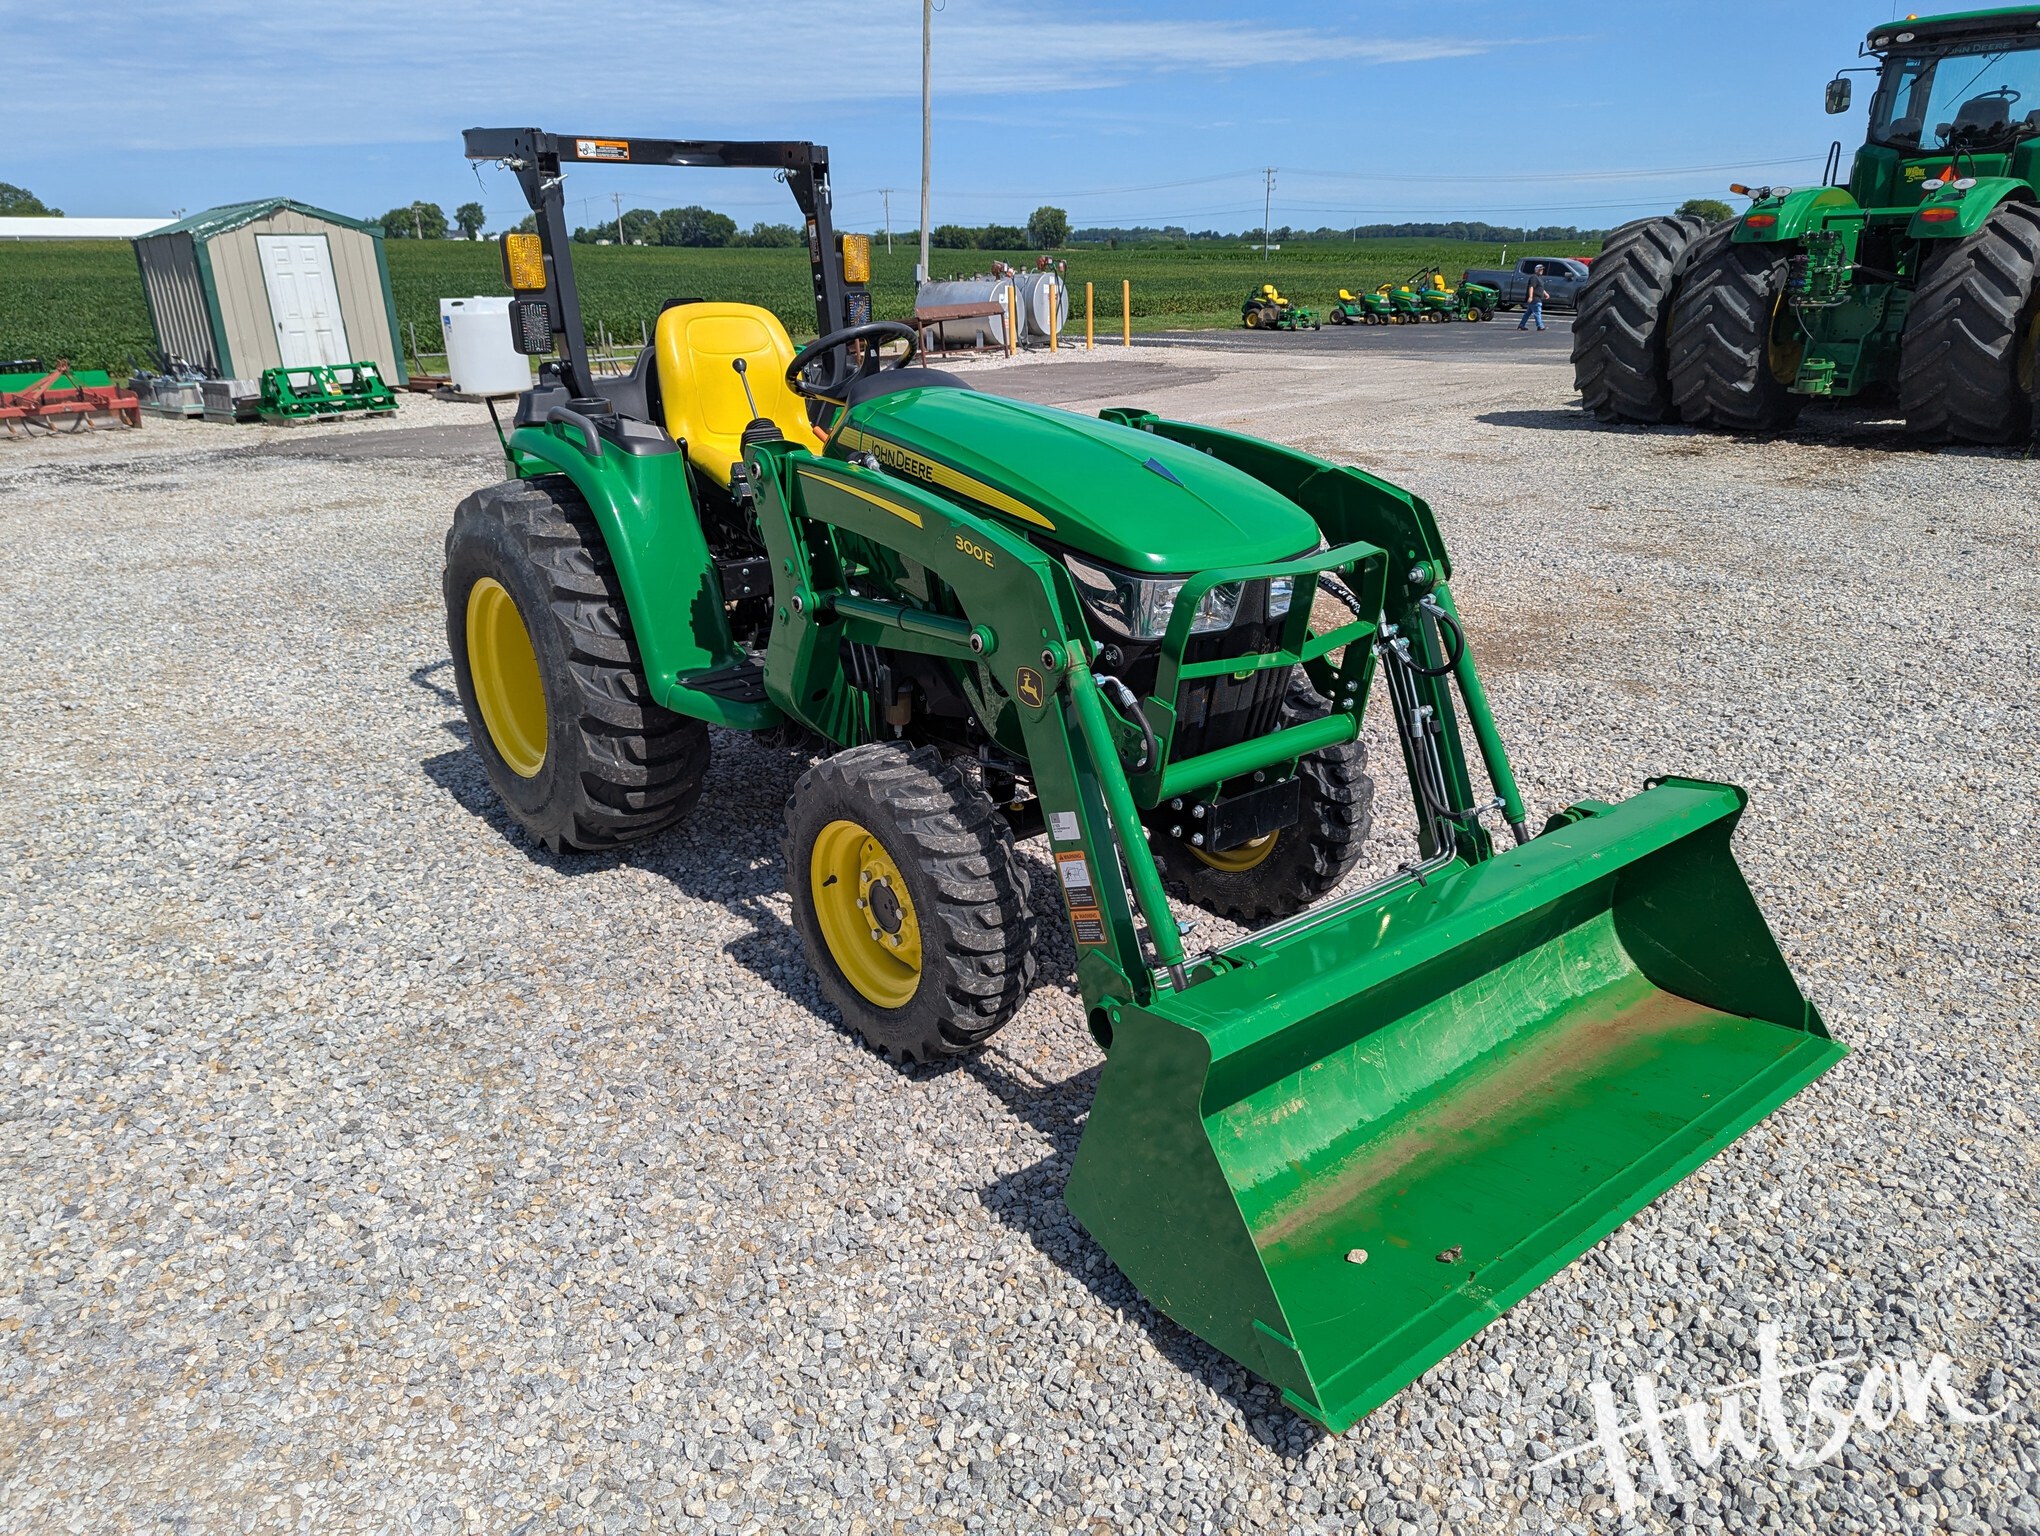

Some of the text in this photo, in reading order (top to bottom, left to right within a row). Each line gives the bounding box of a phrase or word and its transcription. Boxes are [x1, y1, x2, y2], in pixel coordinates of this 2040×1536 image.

[1972, 42, 2010, 52] DEERE
[871, 440, 933, 481] JOHN DEERE
